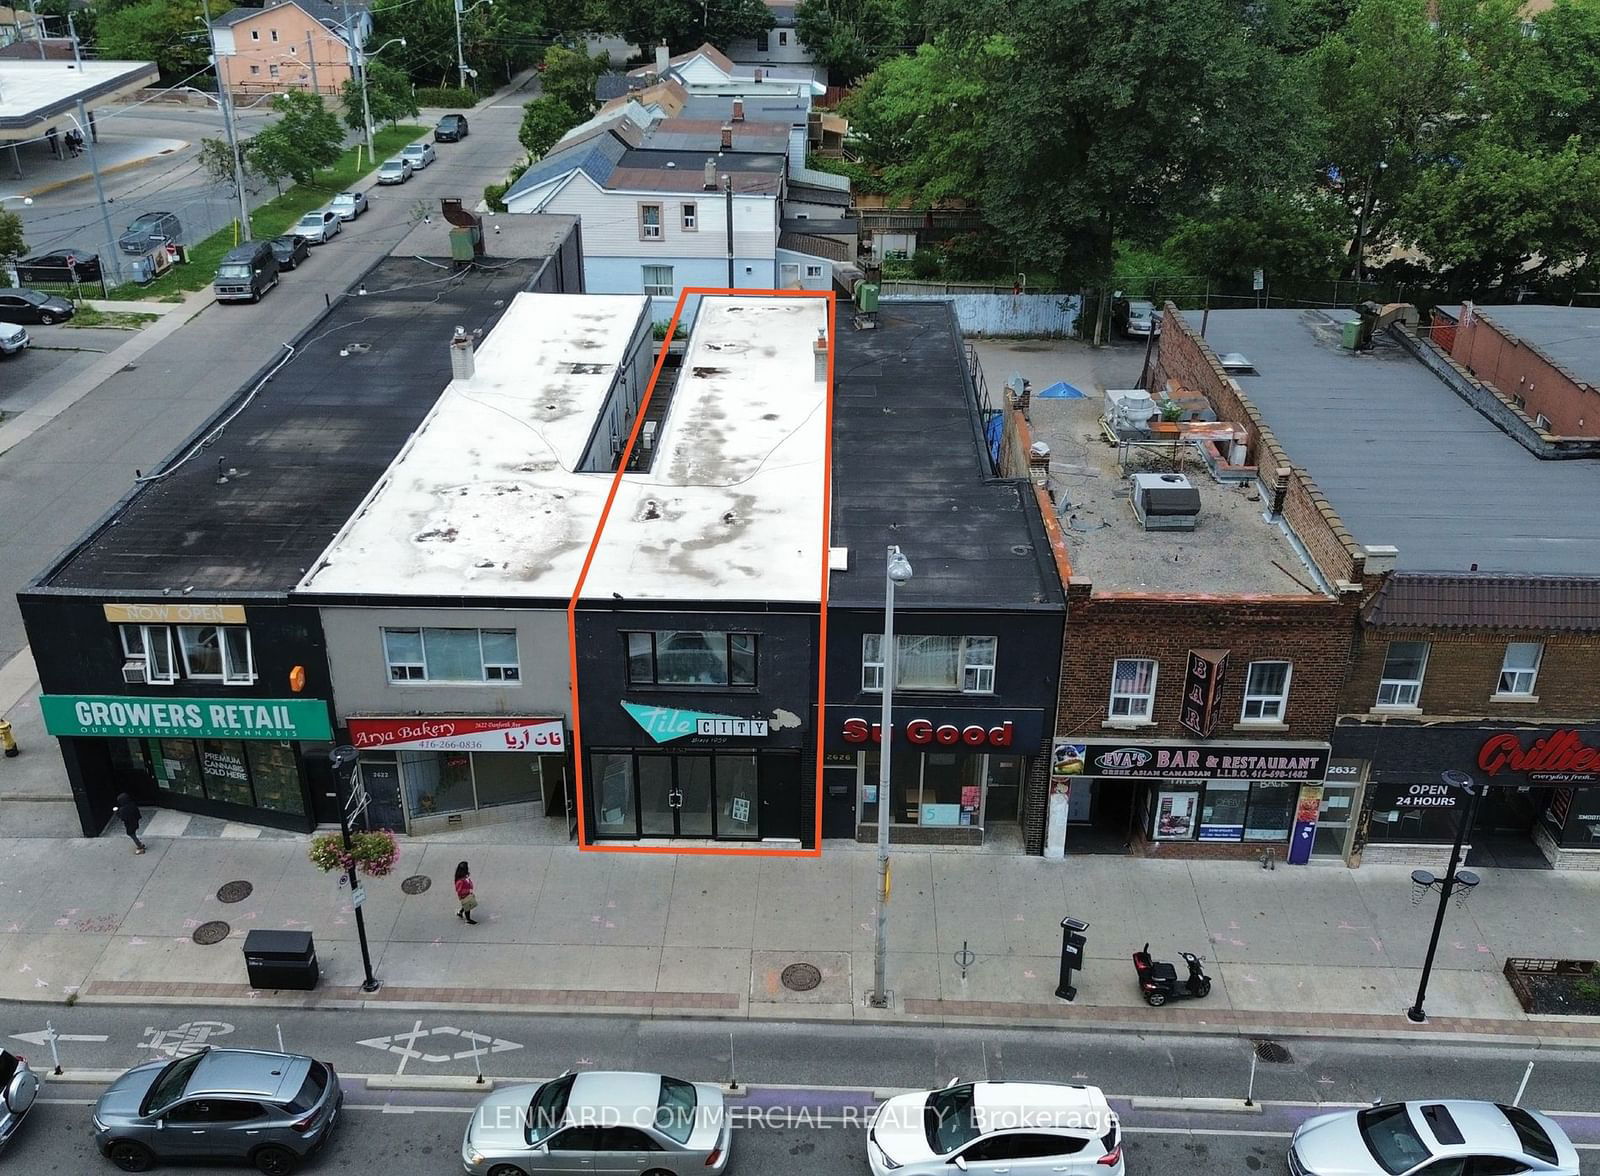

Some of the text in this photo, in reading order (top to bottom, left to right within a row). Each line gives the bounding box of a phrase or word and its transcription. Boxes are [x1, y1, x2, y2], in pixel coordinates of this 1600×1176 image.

[128, 607, 224, 620] NOW OPEN
[1185, 656, 1207, 731] BAR
[75, 701, 295, 729] GROWERS RETAIL
[640, 706, 764, 735] Tile CITY
[354, 721, 455, 746] Arya Bakery
[906, 718, 1014, 747] Good
[418, 740, 482, 749] 416-266-0836
[204, 752, 241, 765] PREMIUM
[1103, 750, 1319, 769] EVA'S BAR & RESTAURANT
[204, 760, 244, 772] CANNABIS
[1328, 766, 1357, 774] 2632
[204, 767, 248, 781] SOLD HERE
[1532, 773, 1568, 781] everyday
[1409, 784, 1448, 795] OPEN
[1396, 797, 1456, 806] 24 HOURS
